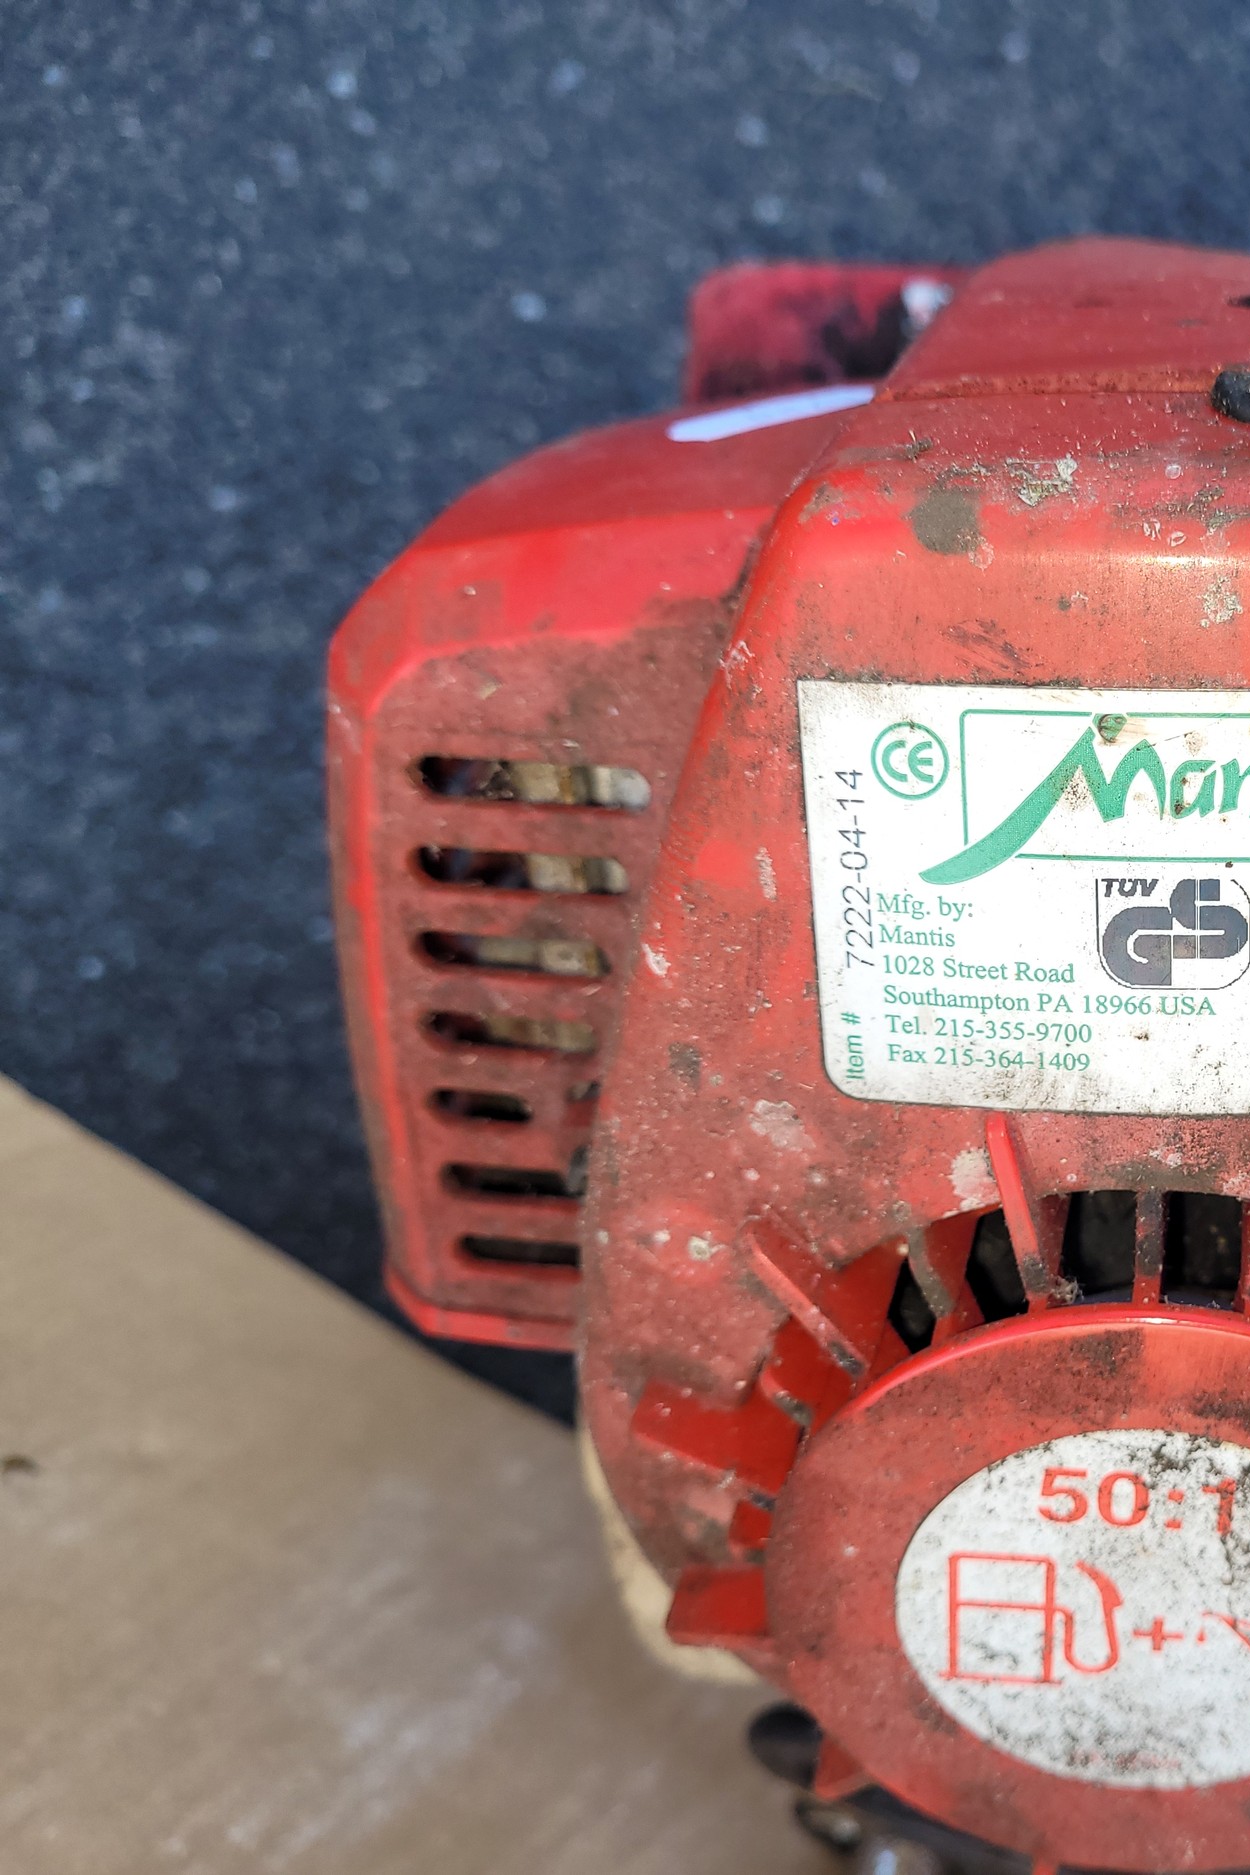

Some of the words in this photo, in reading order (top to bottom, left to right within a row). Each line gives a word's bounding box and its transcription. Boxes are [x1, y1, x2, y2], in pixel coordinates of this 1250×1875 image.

[882, 740, 934, 782] CE
[835, 769, 874, 968] 7222-04-14
[877, 893, 931, 920] Mfg.
[938, 894, 974, 922] by:
[879, 924, 956, 948] Mantis
[883, 955, 934, 978] 1028
[942, 957, 1007, 982] Street
[1014, 962, 1075, 984] Road
[883, 985, 1031, 1015] Southampton
[1037, 991, 1072, 1013] PA
[1083, 993, 1152, 1016] 18966
[1159, 997, 1217, 1016] USA
[888, 1013, 927, 1036] Tel.
[934, 1016, 1092, 1043] 215-355-9700
[846, 1034, 866, 1081] Item
[887, 1043, 928, 1065] Fax
[933, 1046, 1091, 1072] 215-364-1409
[1038, 1467, 1236, 1534] 50:1
